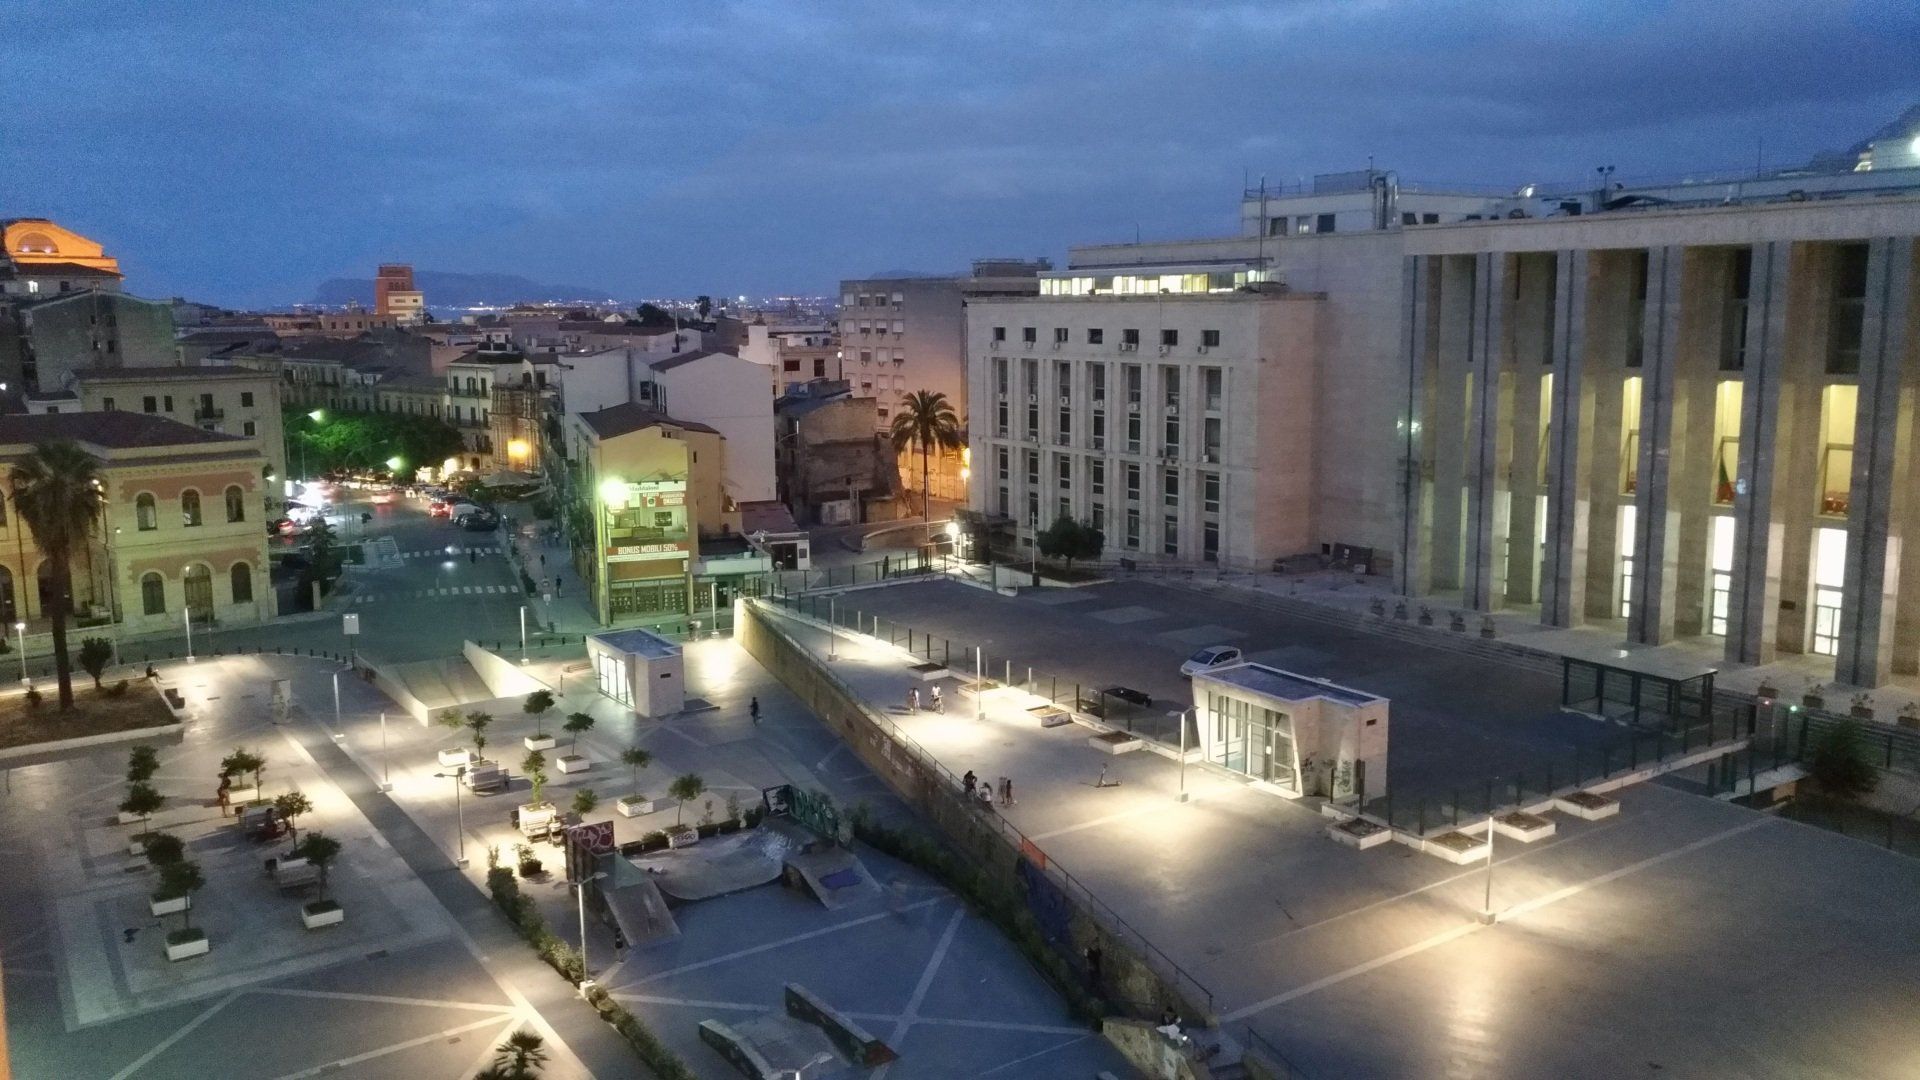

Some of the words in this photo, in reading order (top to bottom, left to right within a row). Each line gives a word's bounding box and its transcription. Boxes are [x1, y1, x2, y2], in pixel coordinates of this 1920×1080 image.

[617, 545, 640, 555] BONUS
[640, 544, 662, 553] MOBILI
[663, 543, 679, 552] 50%
